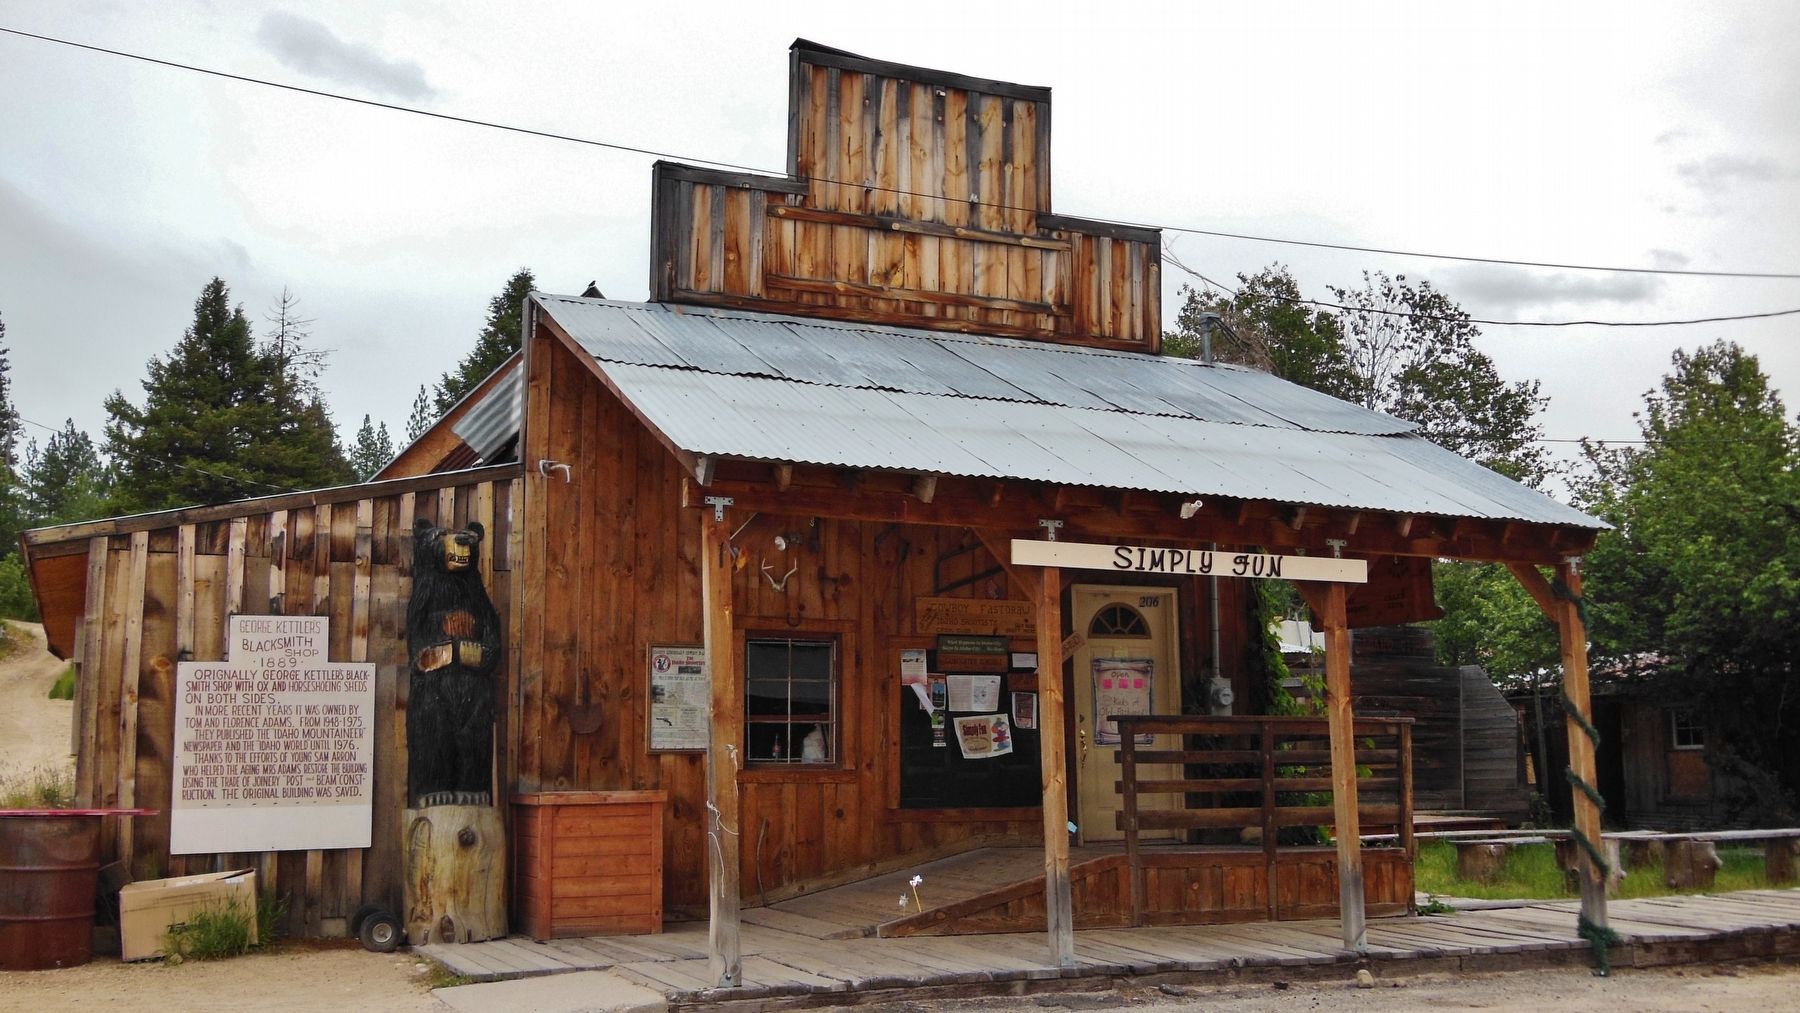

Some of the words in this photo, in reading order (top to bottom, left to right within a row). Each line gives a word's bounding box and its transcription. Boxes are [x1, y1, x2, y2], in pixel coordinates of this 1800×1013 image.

[1113, 546, 1214, 574] SIMPLY
[1232, 553, 1284, 577] FUN
[1139, 596, 1160, 607] 206
[240, 620, 272, 633] GEORGE
[242, 636, 313, 651] BLACKSMITH
[261, 657, 297, 668] 1889
[194, 669, 258, 681] ORIGNALLY
[263, 669, 300, 681] GEORGE
[186, 681, 212, 693] SMITH
[213, 681, 233, 693] SHOP
[235, 681, 254, 692] WITH
[257, 682, 268, 692] OX
[272, 681, 287, 692] AND
[344, 681, 367, 692] SHEDS
[185, 693, 202, 705] ON
[207, 693, 237, 704] BOTH
[242, 693, 280, 704] SIDES.
[195, 705, 204, 716] IN
[204, 705, 228, 716] MORE
[231, 705, 262, 716] RECENT
[266, 704, 293, 715] YEARS
[296, 704, 303, 715] IT
[304, 705, 320, 715] WAS
[322, 704, 347, 715] OWNED
[349, 704, 360, 715] BY
[185, 717, 203, 728] TOM
[204, 717, 220, 728] AND
[222, 717, 259, 728] FLORENCE
[300, 717, 321, 727] FROM
[195, 729, 215, 740] THEY
[216, 729, 254, 740] PUBLISHED
[257, 729, 270, 740] THE
[184, 741, 223, 752] NEWSPAPER
[225, 741, 241, 751] AND
[242, 741, 255, 751] THE
[311, 740, 330, 750] UNTIL
[194, 753, 223, 764] THANKS
[225, 753, 233, 764] TO
[235, 753, 247, 763] THE
[249, 753, 278, 763] EFFORTS
[279, 752, 289, 763] OF
[291, 752, 312, 763] YOUNG
[314, 752, 329, 762] SAM
[331, 751, 357, 762] ARRON
[183, 765, 199, 776] WHO
[201, 765, 224, 776] HELPED
[226, 765, 239, 775] THE
[240, 764, 260, 775] AGING
[277, 764, 301, 774] ADAMS
[303, 763, 328, 774] RESTORE
[331, 763, 341, 773] THE
[342, 763, 367, 774] BUILDING
[183, 777, 204, 788] USING
[206, 777, 218, 787] THE
[221, 776, 239, 787] TRADE
[242, 776, 252, 787] OF
[252, 776, 280, 787] JOINERY
[222, 789, 238, 799] THE
[242, 788, 279, 799] ORIGINAL
[282, 788, 313, 798] BUILDING
[315, 788, 332, 798] WAS
